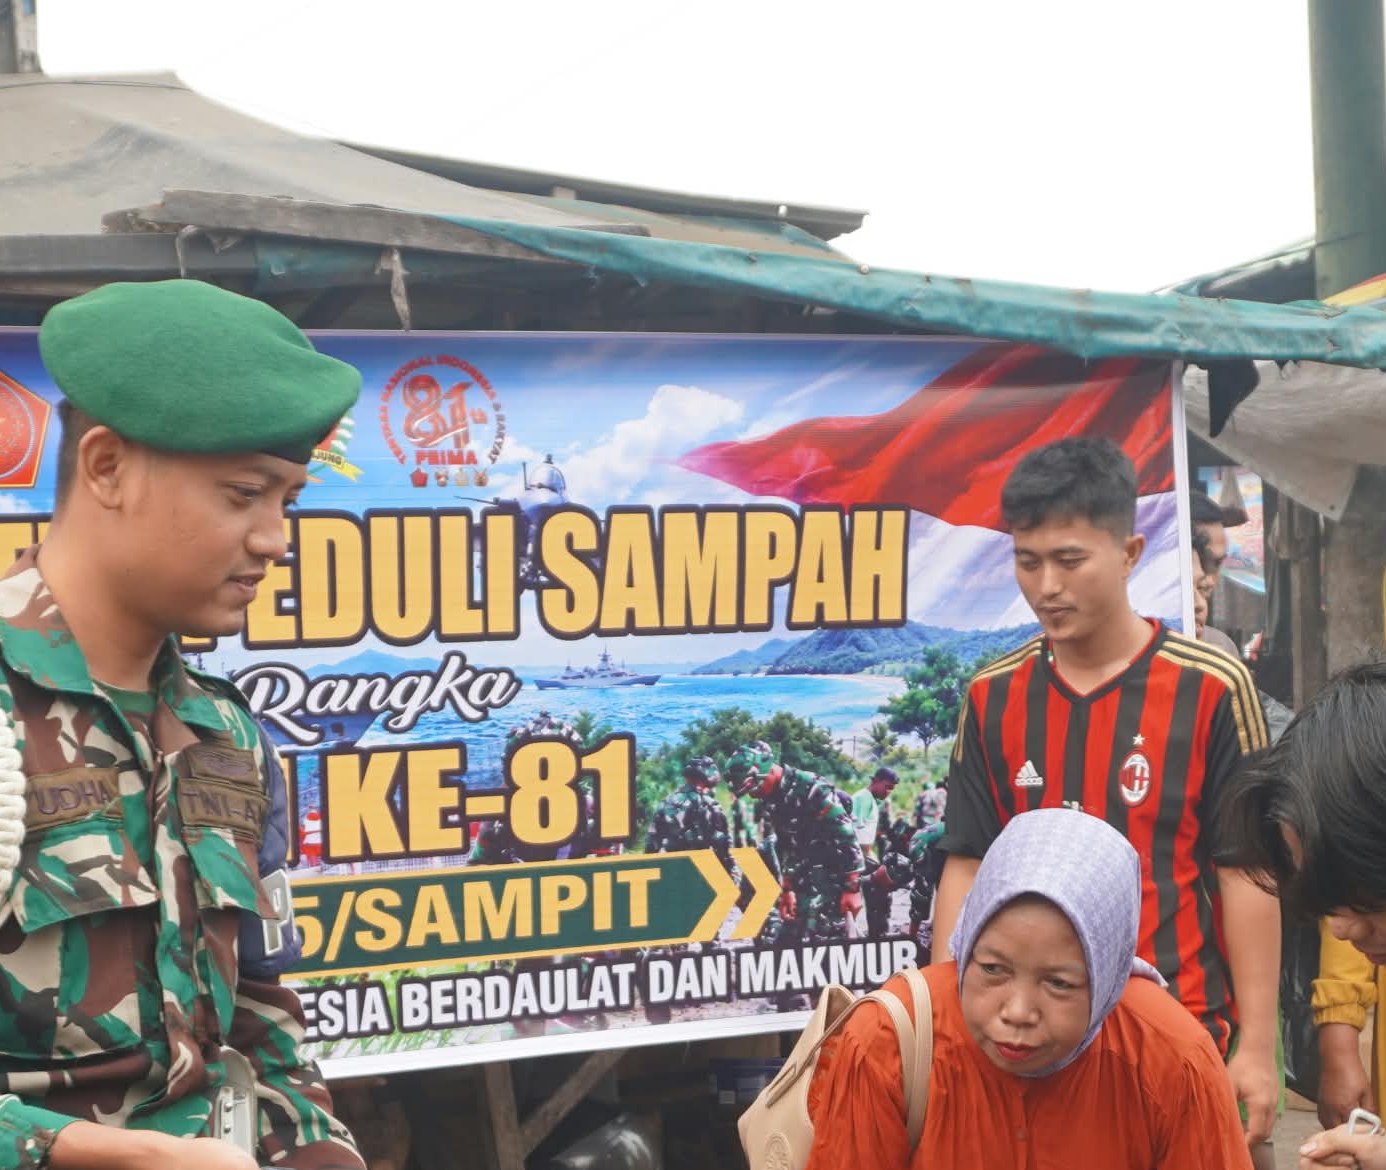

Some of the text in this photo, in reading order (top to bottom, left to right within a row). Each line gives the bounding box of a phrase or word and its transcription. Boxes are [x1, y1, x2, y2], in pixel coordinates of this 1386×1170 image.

[181, 513, 515, 646] EDULI
[541, 509, 908, 633] SAMPAH
[235, 654, 518, 743] Rangka
[326, 738, 630, 858] KE-81
[401, 963, 638, 1029] BERDAULAT
[649, 954, 728, 1001] DAN
